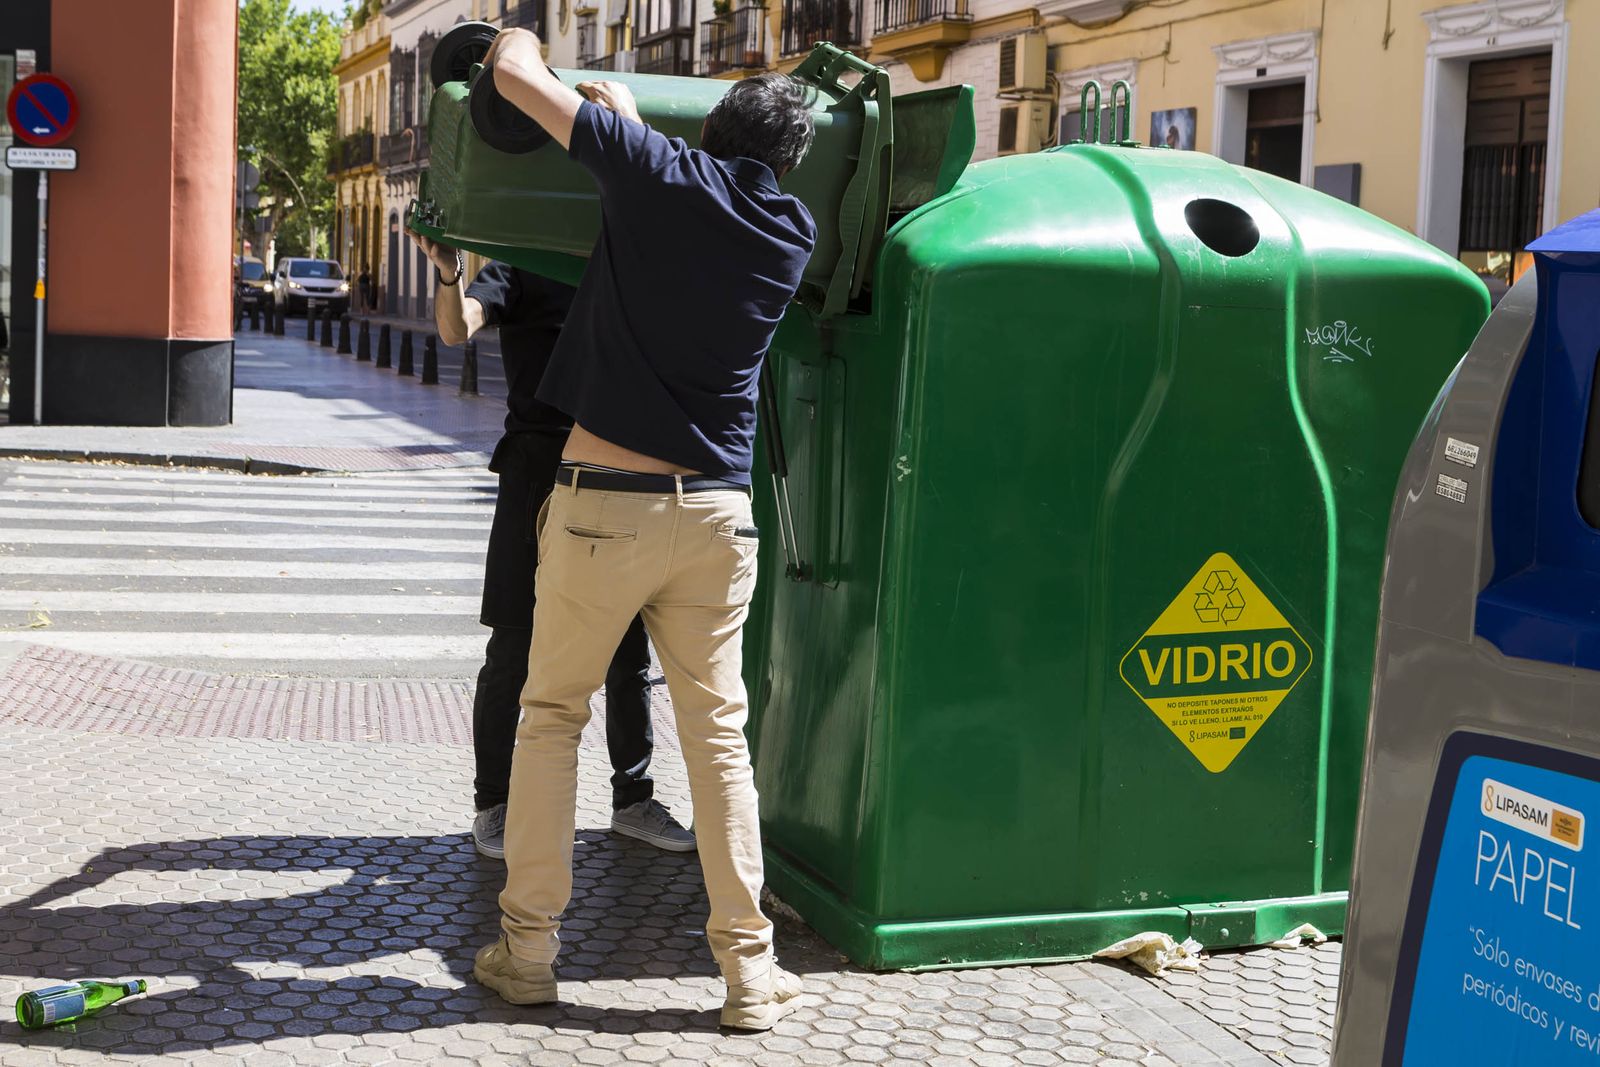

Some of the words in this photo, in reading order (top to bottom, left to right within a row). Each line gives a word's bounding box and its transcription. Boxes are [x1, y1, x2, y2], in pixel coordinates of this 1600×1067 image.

[1138, 640, 1296, 686] VIDRIO
[1178, 700, 1209, 708] DEPOSITE
[1210, 698, 1239, 706] TAPONES
[1182, 708, 1220, 716] ELEMENTOS
[1221, 705, 1254, 714] EXTRAÑOS
[1196, 731, 1228, 739] LIPASAM
[1496, 795, 1549, 827] LIPASAM
[1474, 830, 1581, 930] PAPEL
[1514, 958, 1583, 1003] envases
[1462, 972, 1548, 1029] periódicos
[1553, 1016, 1565, 1041] y
